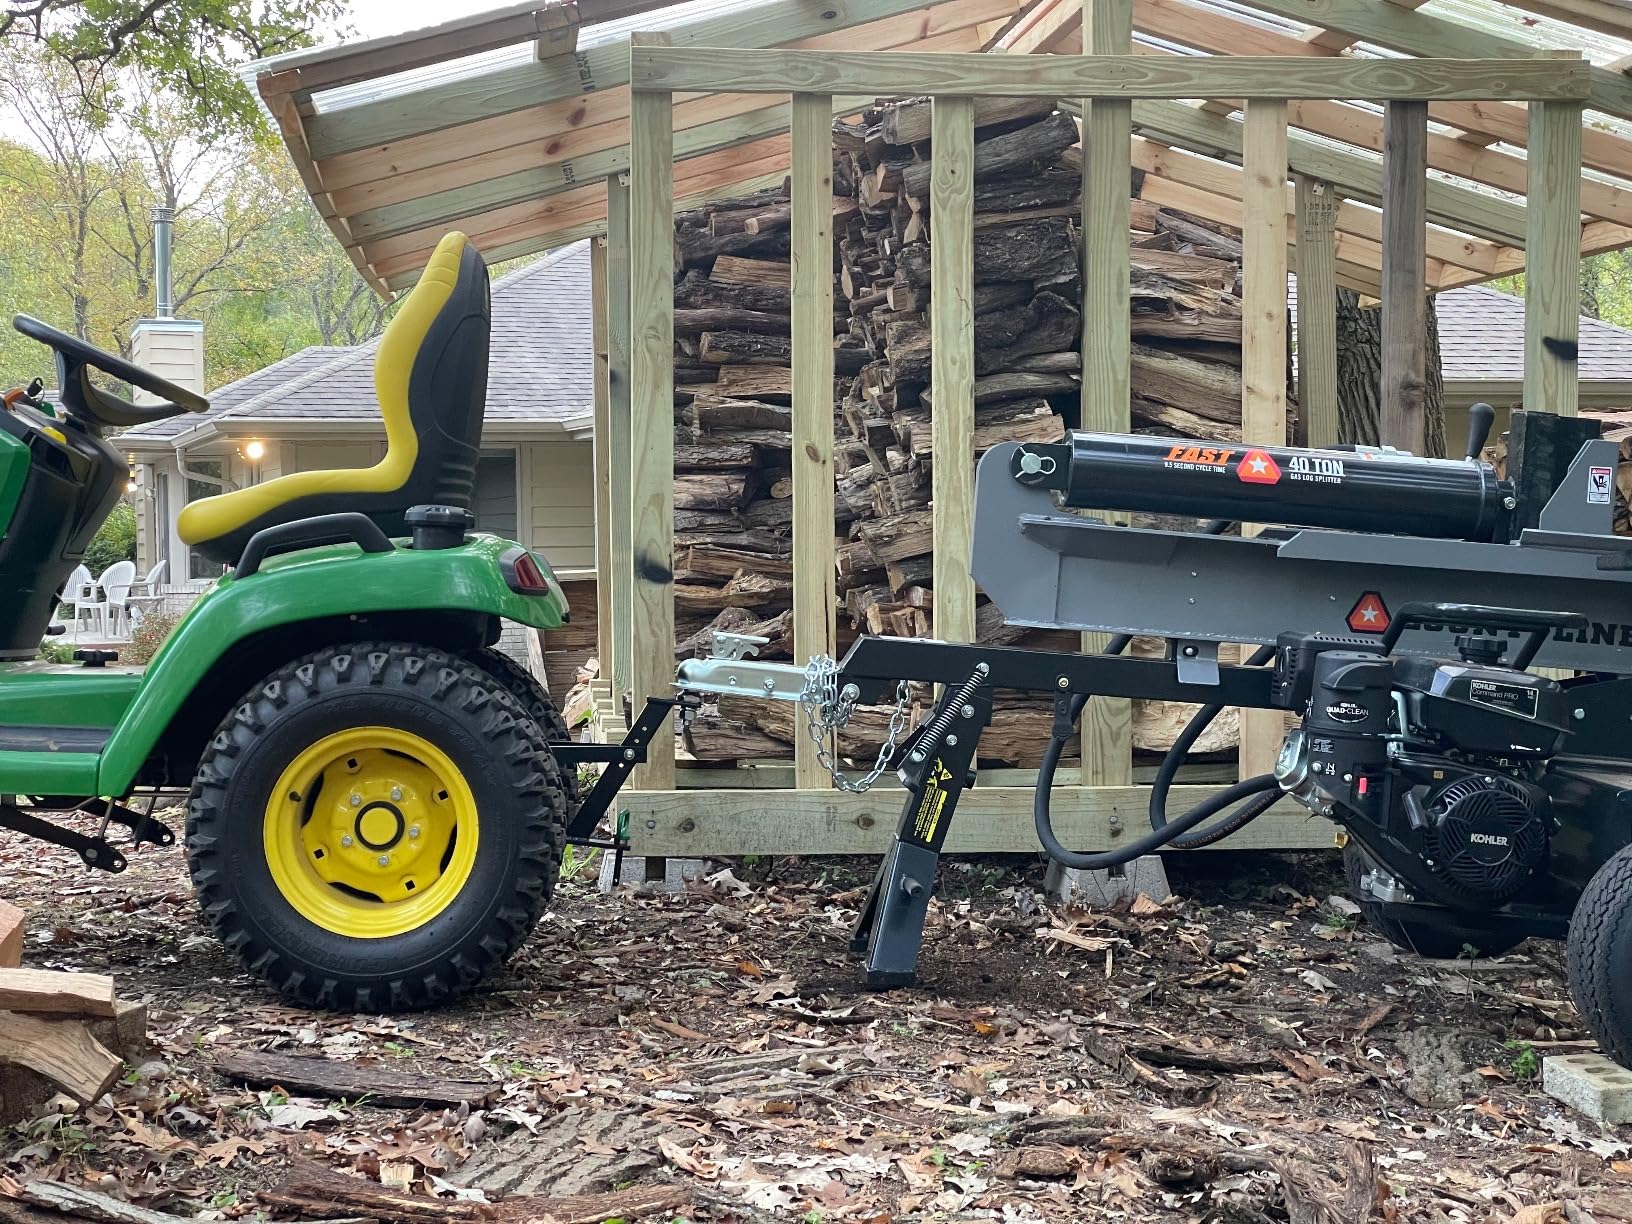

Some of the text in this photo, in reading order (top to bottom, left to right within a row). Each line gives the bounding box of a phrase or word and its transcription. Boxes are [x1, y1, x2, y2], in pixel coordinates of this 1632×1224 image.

[1166, 446, 1235, 465] FAST
[1195, 464, 1212, 472] CYCLE
[1289, 456, 1344, 476] 40 TON
[1315, 475, 1342, 483] SPLITTER
[1472, 682, 1497, 691] KOHLER
[1472, 688, 1503, 698] Command
[1326, 706, 1369, 716] QUAD-CLEAN
[1470, 833, 1508, 846] KOHLER
